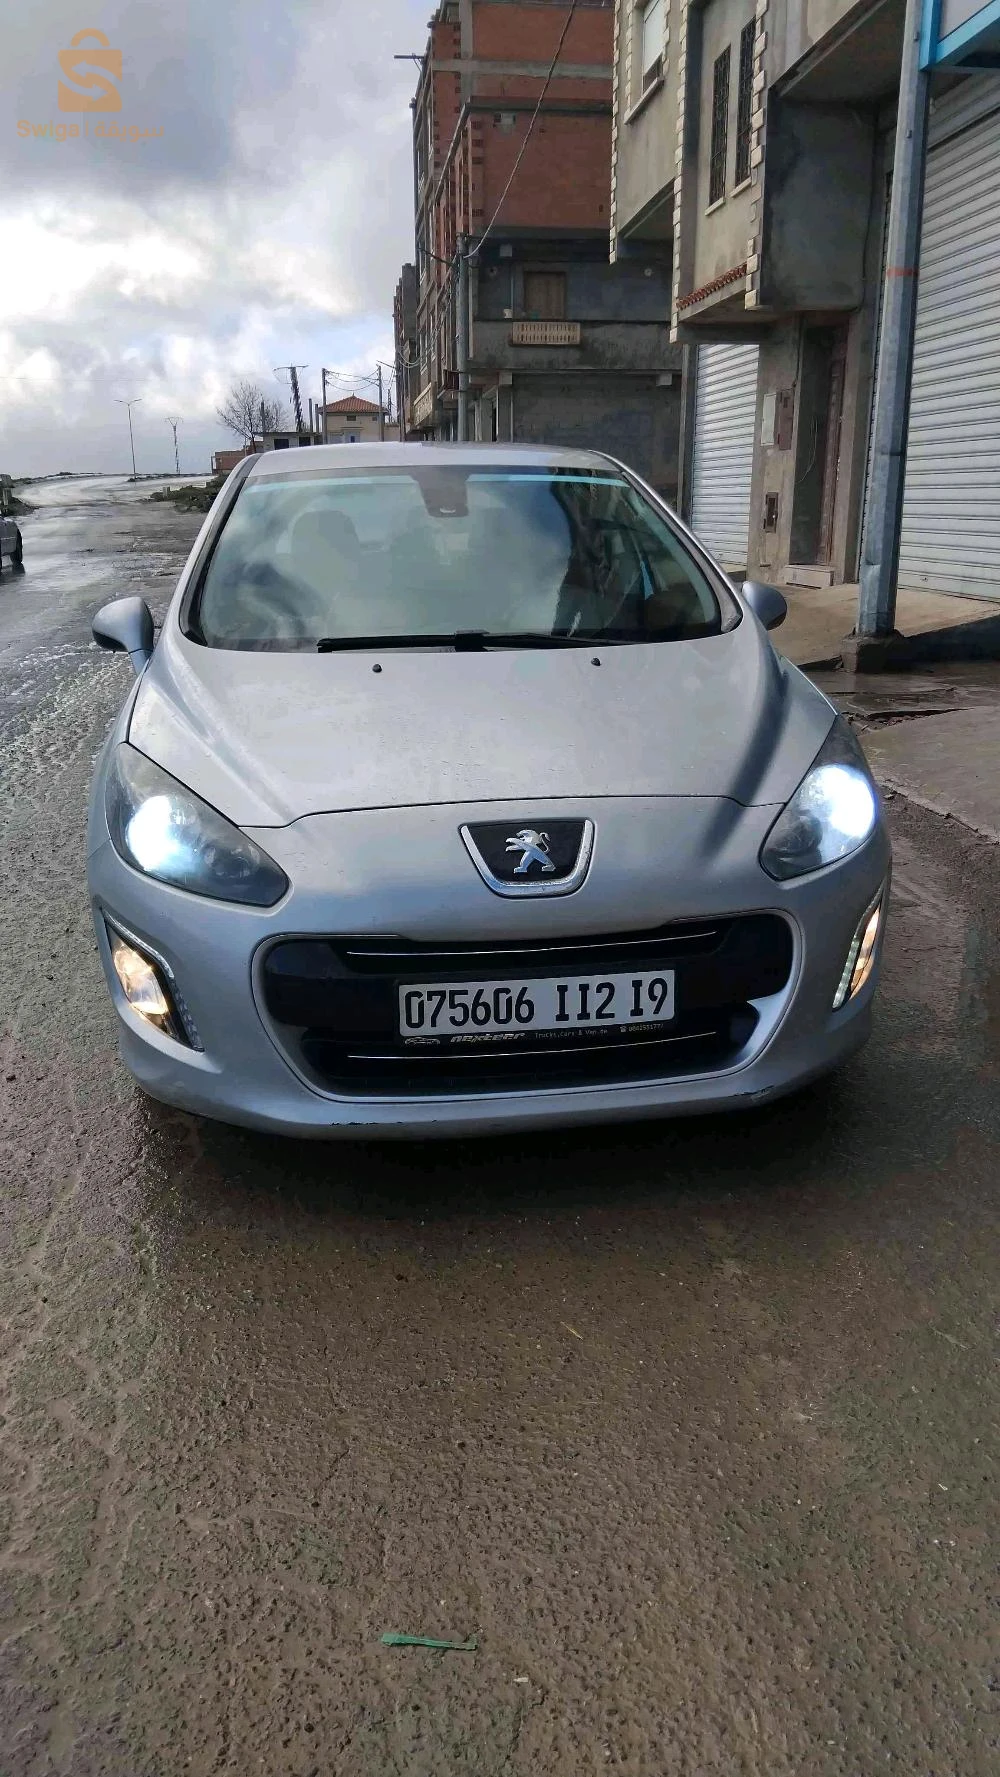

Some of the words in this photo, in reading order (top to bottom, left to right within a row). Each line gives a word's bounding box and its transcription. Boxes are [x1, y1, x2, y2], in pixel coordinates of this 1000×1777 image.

[405, 987, 535, 1028] 075606
[555, 982, 616, 1022] 112
[630, 977, 668, 1016] 19
